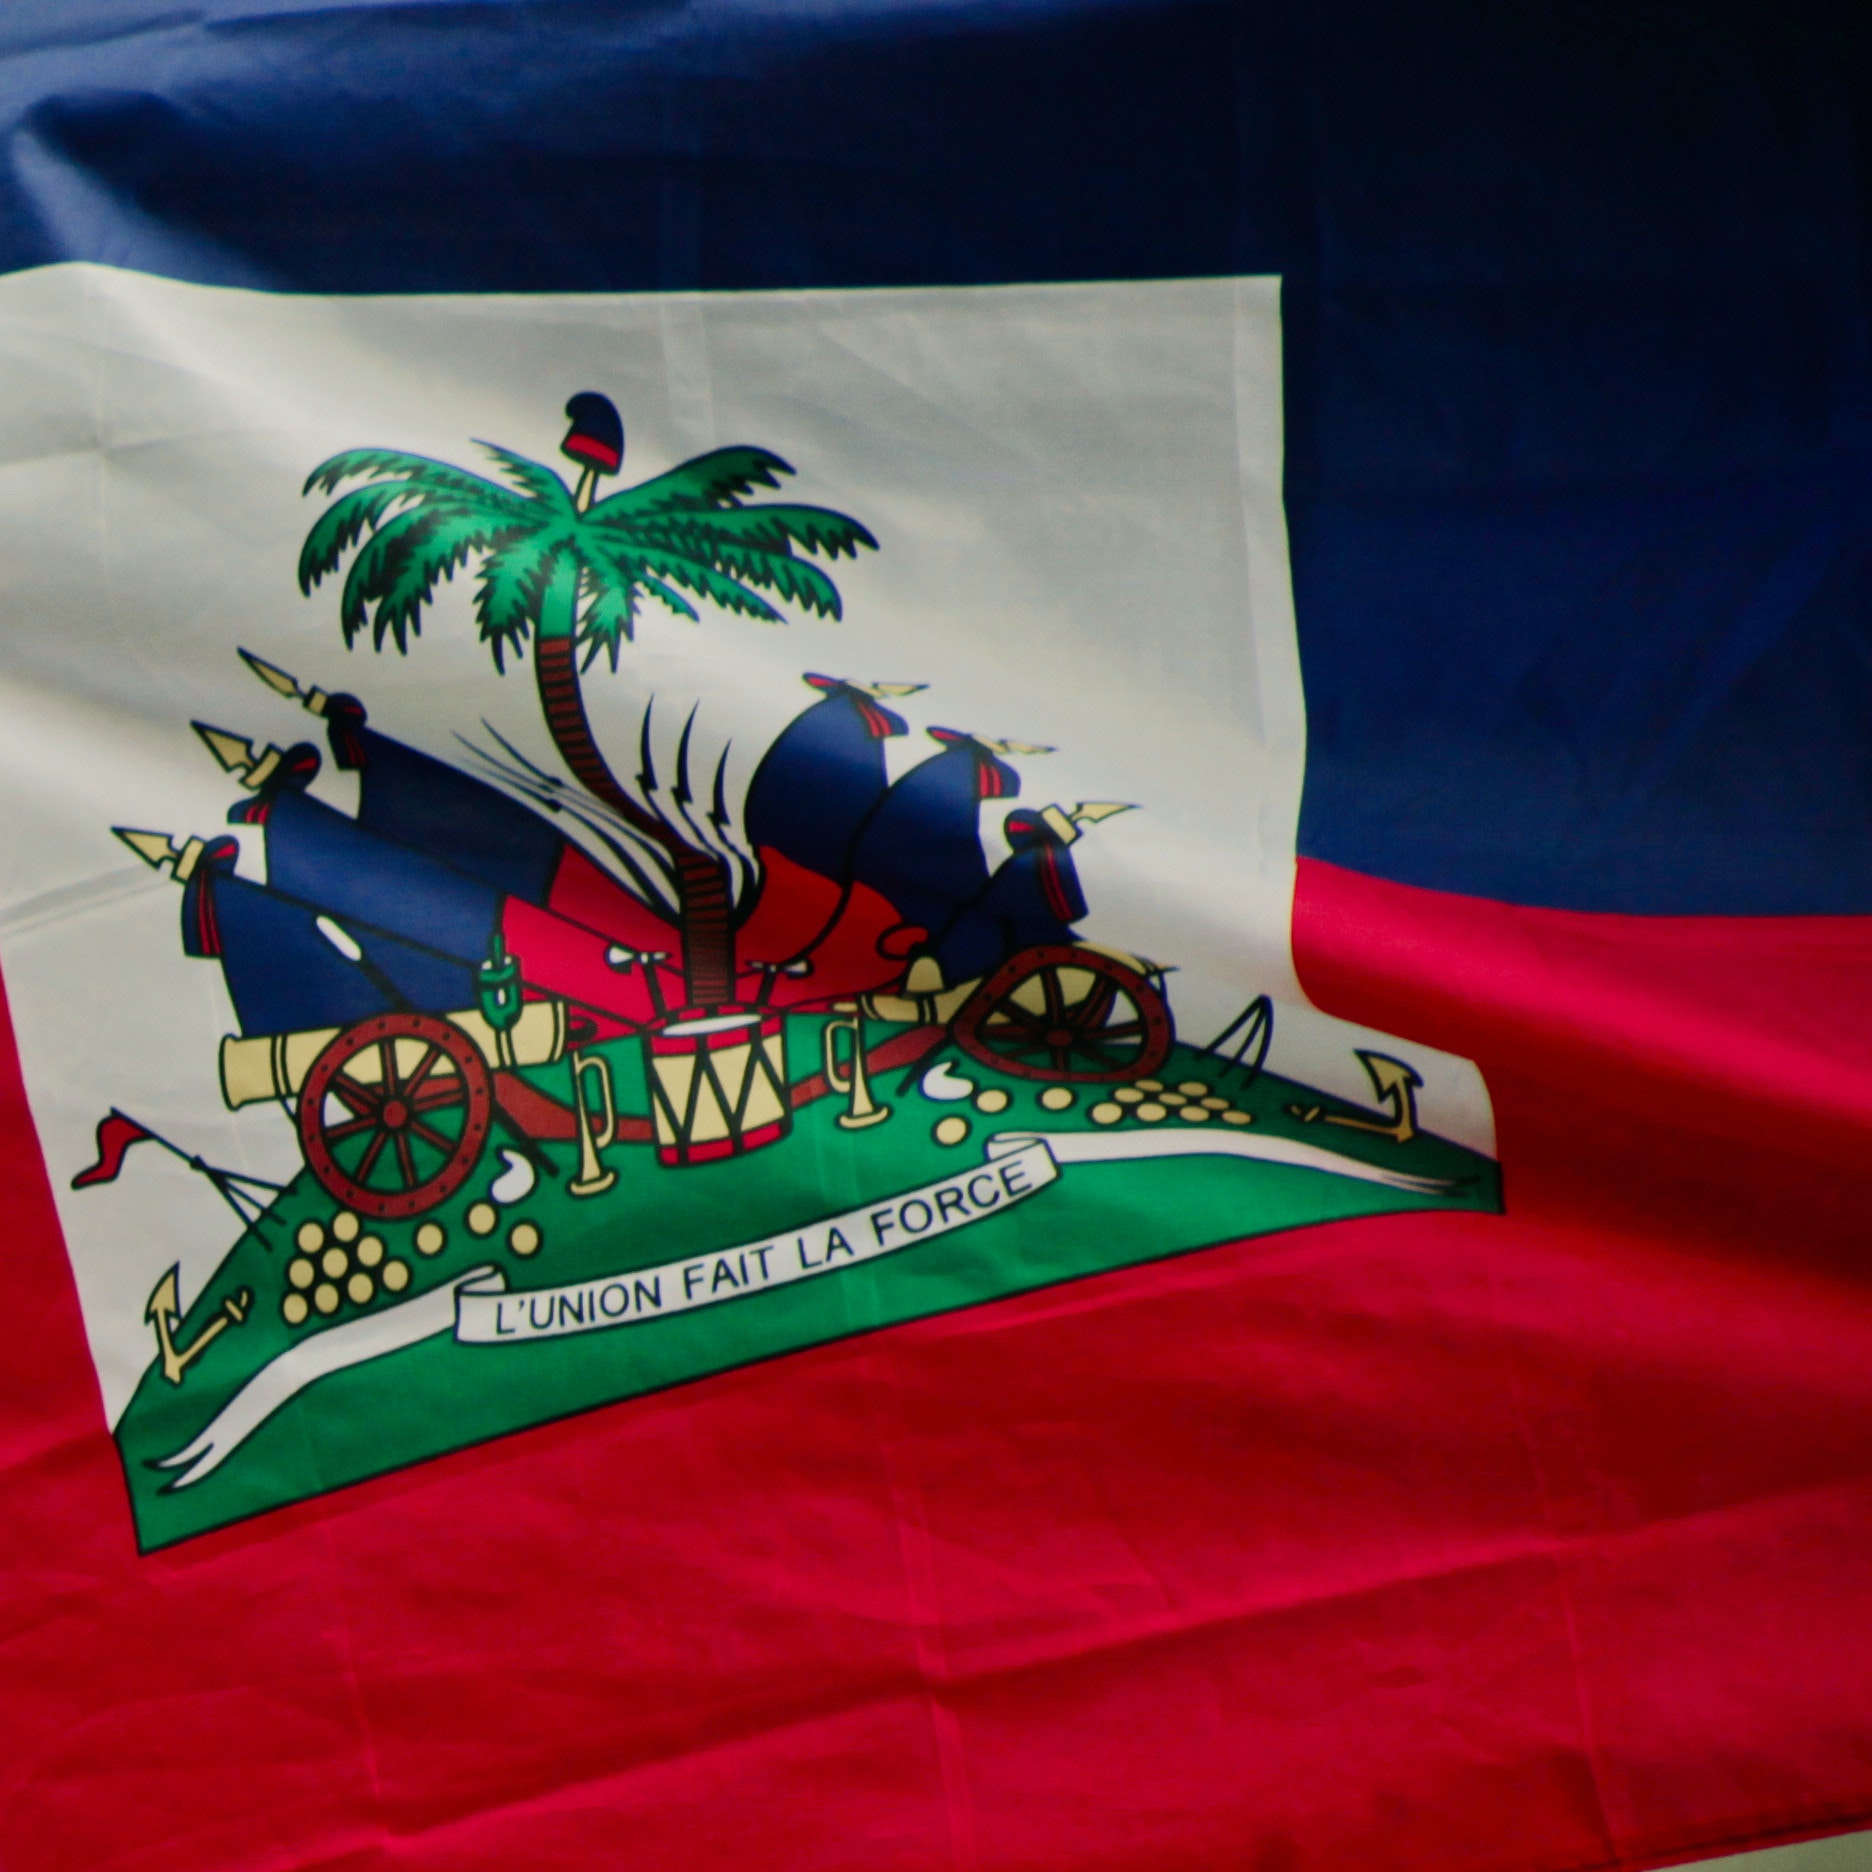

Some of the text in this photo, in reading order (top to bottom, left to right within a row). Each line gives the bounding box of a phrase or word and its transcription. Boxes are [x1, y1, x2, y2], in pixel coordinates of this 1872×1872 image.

[495, 1159, 1033, 1336] L'UNION FAIT LA FORCE
